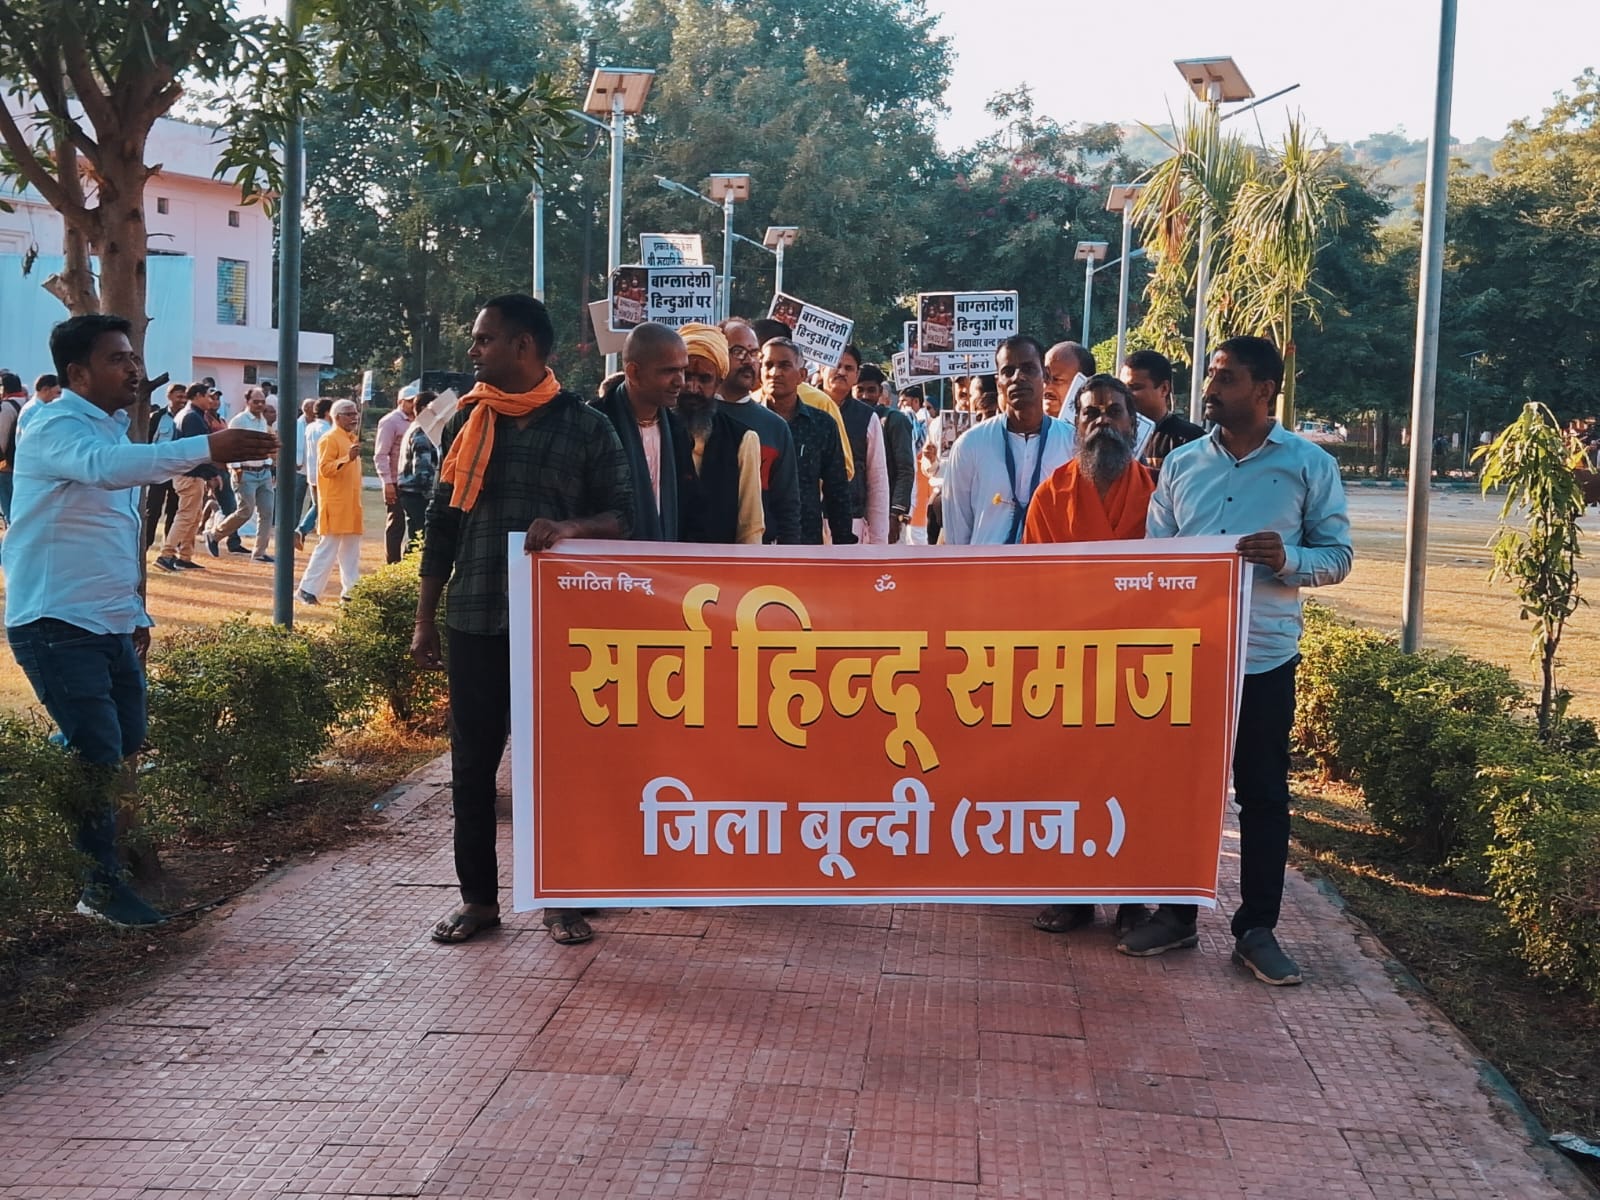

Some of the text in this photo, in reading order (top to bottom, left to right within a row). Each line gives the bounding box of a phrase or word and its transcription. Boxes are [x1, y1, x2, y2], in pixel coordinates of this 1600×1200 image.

[696, 295, 712, 308] पर
[999, 319, 1014, 331] पर
[830, 338, 843, 351] पर
[556, 571, 656, 596] संगठित हिन्दू
[1113, 572, 1198, 591] समर्थ भारत
[568, 583, 1201, 773] सर्व हिन्दू समाज
[639, 776, 788, 856] जिला
[798, 777, 935, 880] बून्दी
